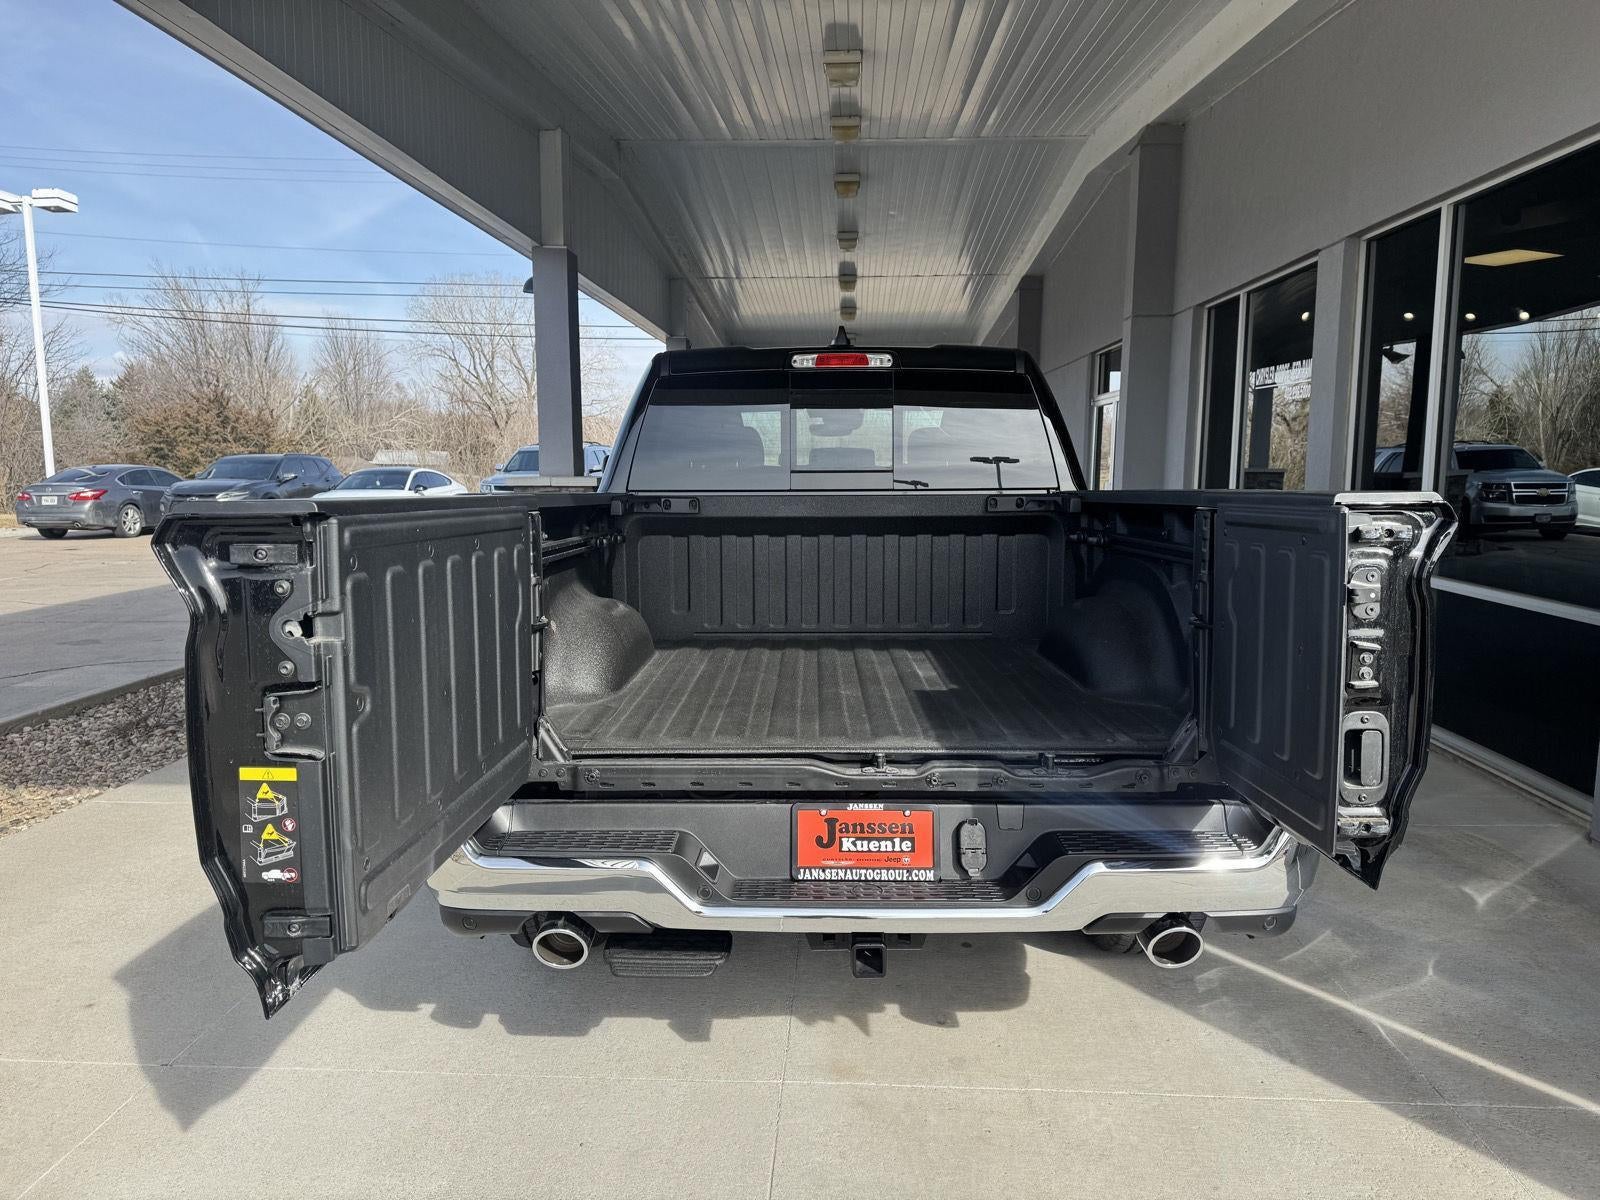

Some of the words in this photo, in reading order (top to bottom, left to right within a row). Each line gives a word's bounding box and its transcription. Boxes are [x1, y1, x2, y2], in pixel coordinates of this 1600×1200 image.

[847, 803, 884, 811] JANSSEN
[815, 817, 914, 849] Janssen
[841, 837, 912, 852] Kuenle
[884, 856, 901, 864] Jeep
